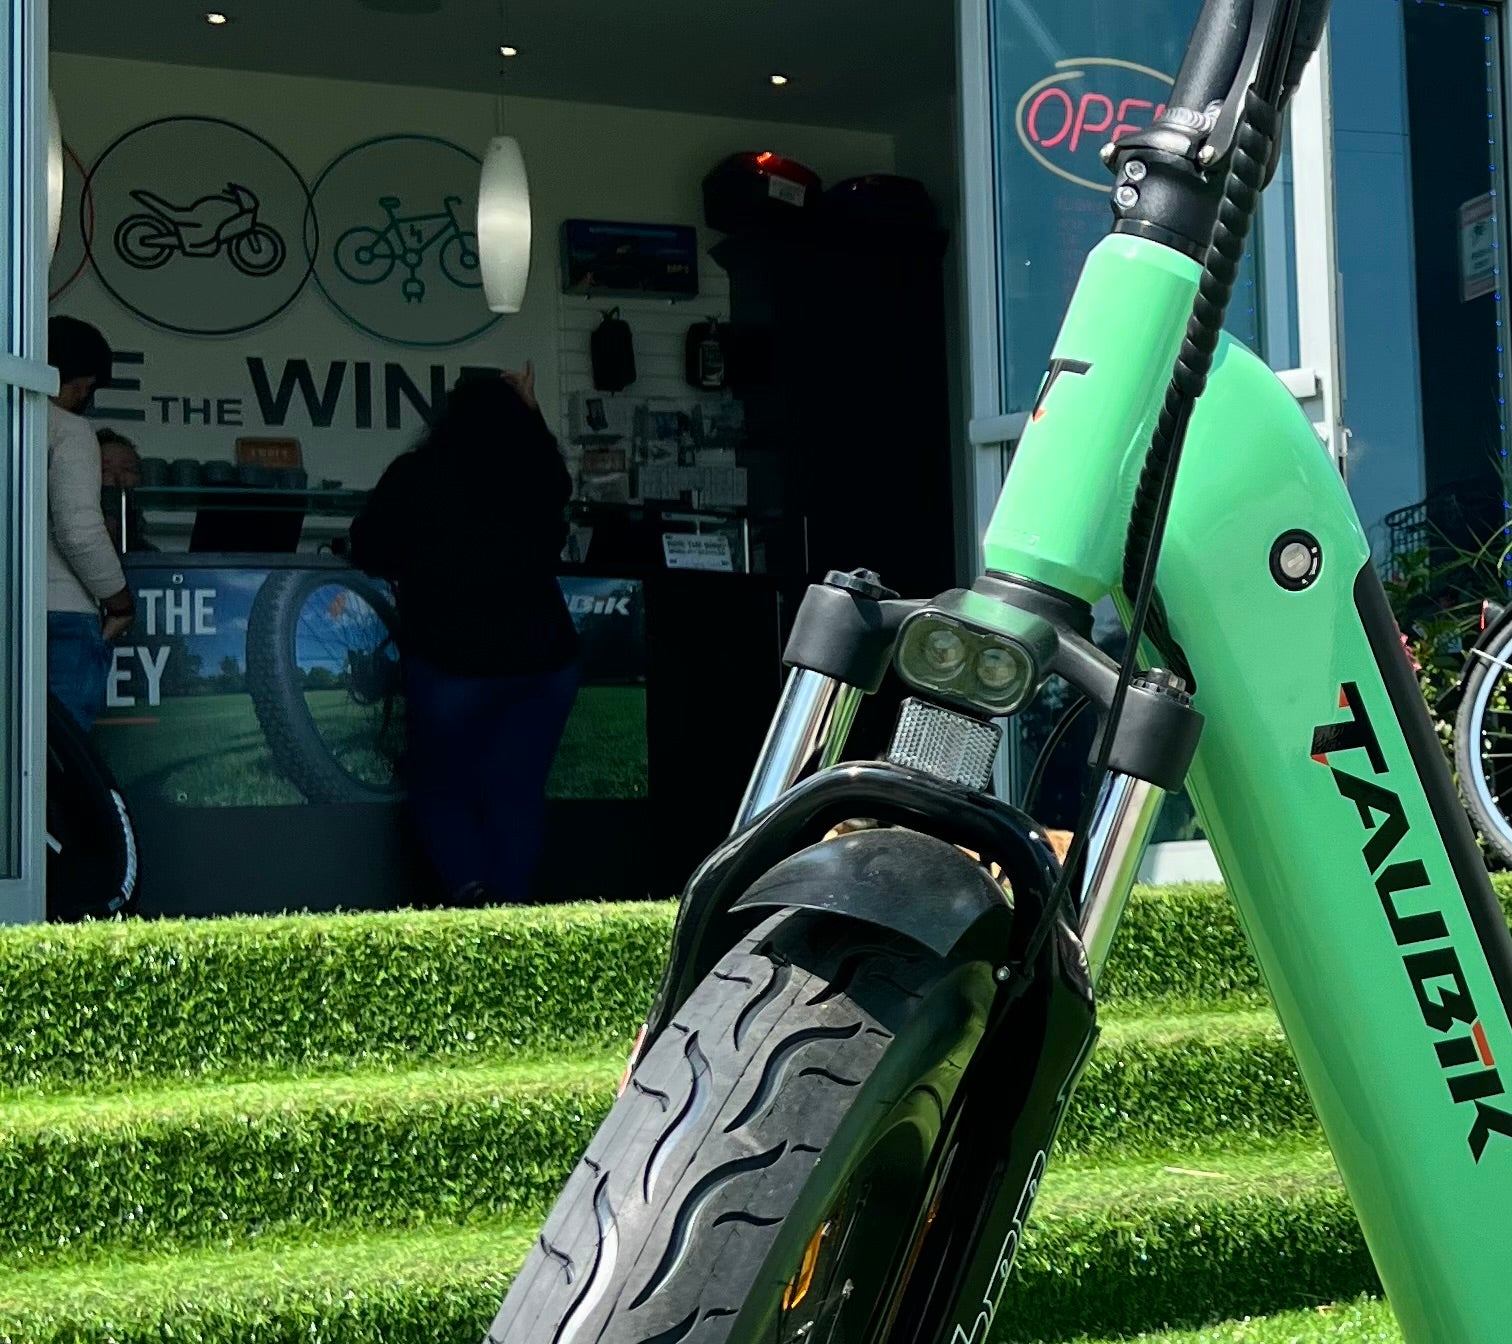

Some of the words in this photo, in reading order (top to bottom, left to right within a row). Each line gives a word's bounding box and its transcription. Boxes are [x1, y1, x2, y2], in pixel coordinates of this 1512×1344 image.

[1027, 87, 1167, 152] OPE
[151, 396, 243, 427] THE
[247, 356, 500, 429] WIN
[137, 587, 217, 636] THE
[106, 645, 171, 708] EY
